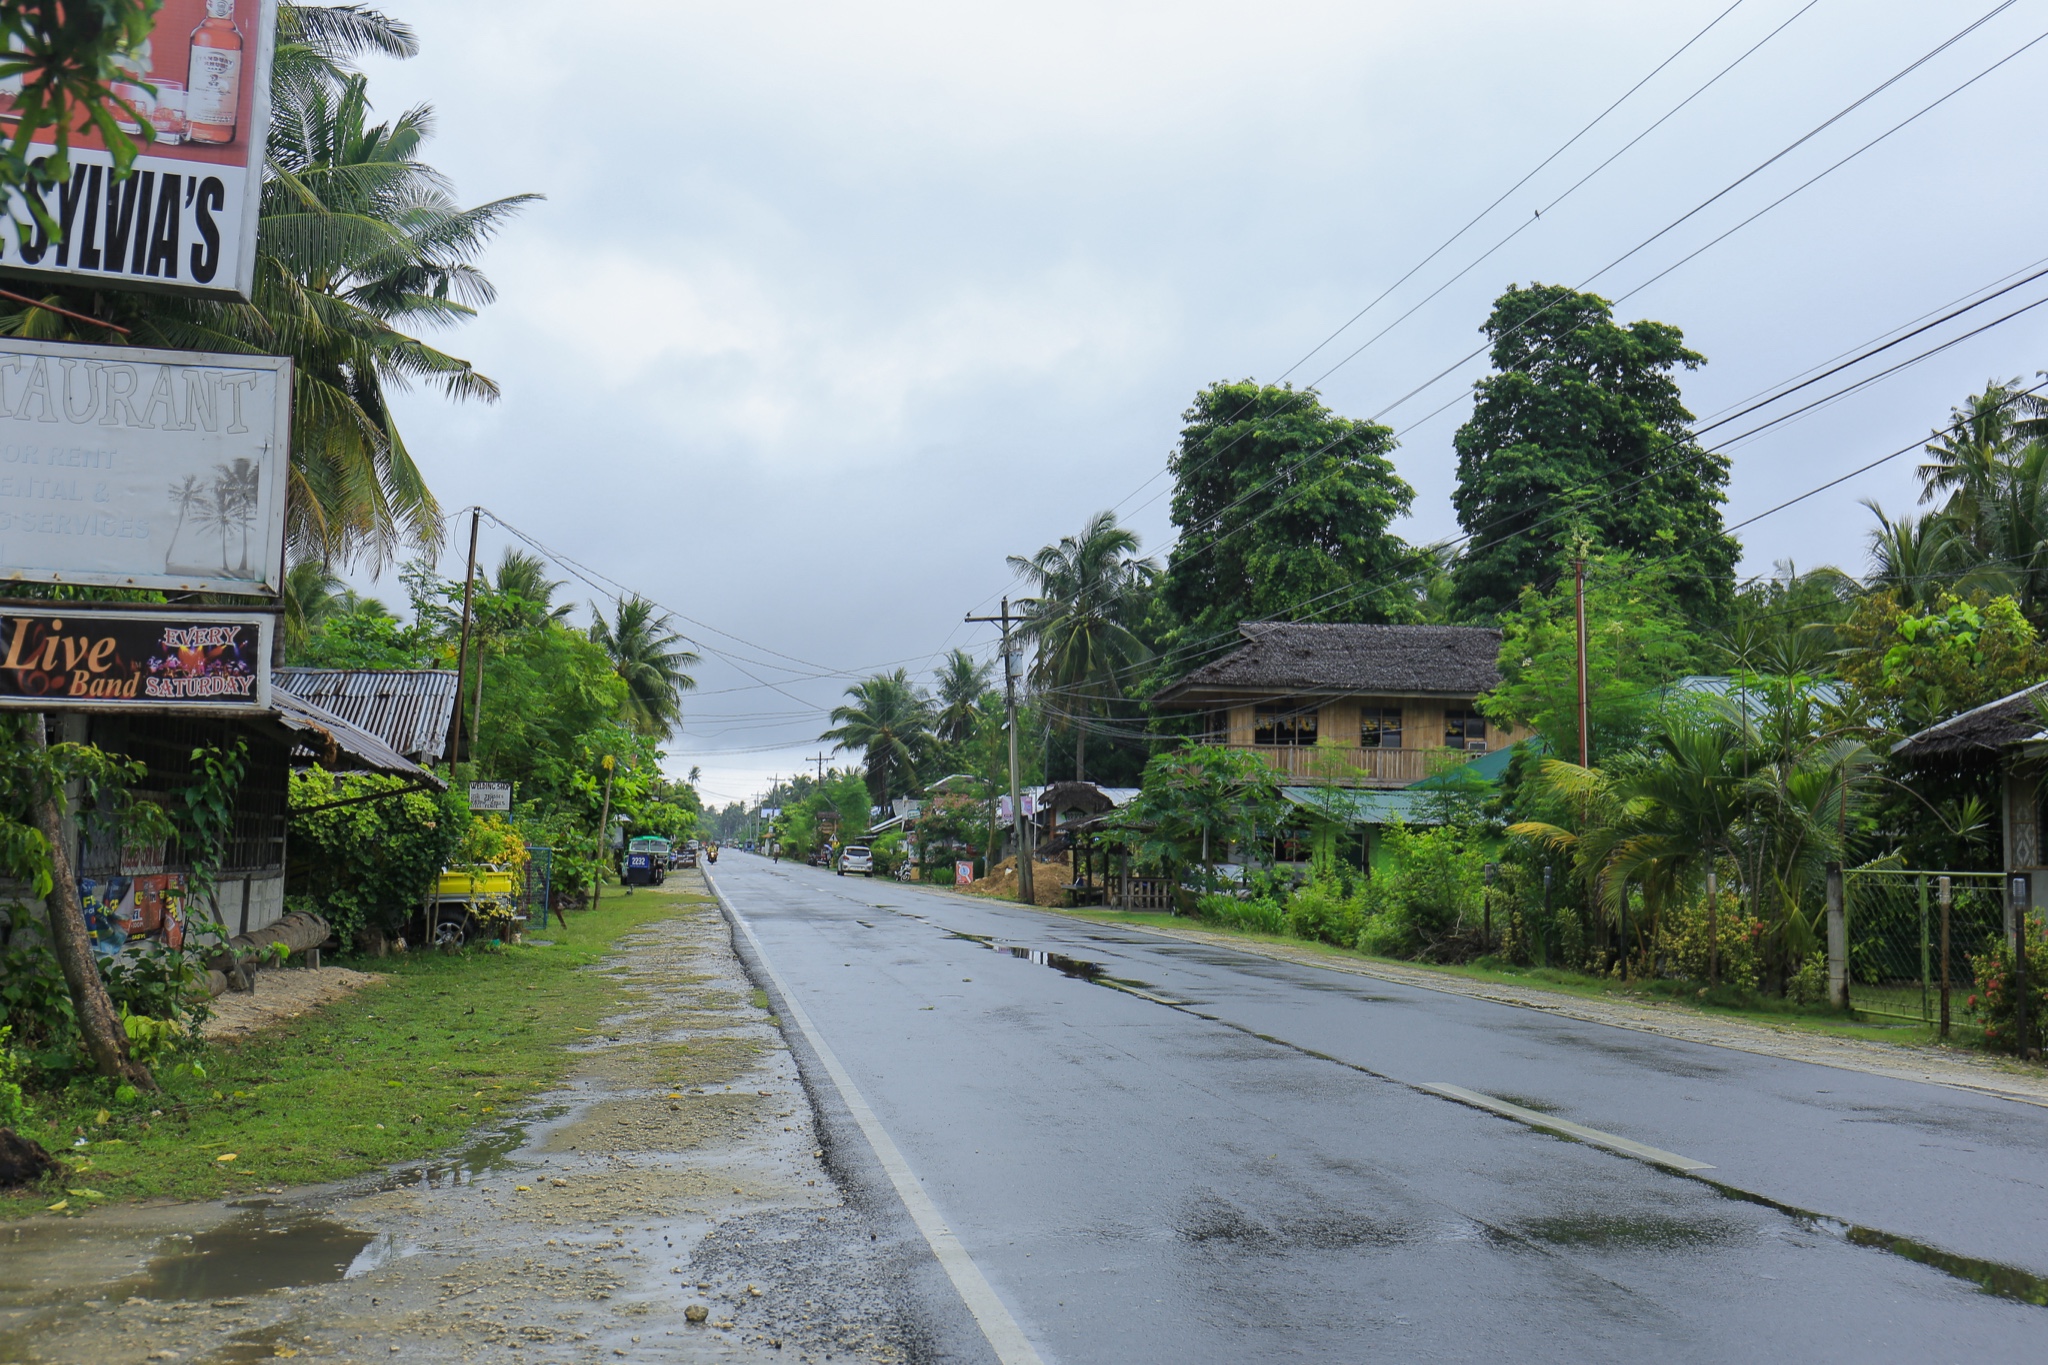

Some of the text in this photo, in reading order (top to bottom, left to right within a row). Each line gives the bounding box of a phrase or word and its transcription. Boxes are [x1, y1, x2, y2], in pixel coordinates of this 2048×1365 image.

[19, 156, 225, 285] SYLVIA'S
[0, 355, 257, 435] TAURANT
[48, 446, 118, 470] RENT
[93, 481, 111, 503] &
[22, 511, 150, 540] SERVICES
[1, 618, 116, 673] Live
[164, 626, 242, 647] EVERY
[68, 669, 140, 698] Band
[145, 675, 256, 698] SATURDAY
[471, 782, 510, 791] WELDING SHOP
[631, 857, 646, 866] 2232
